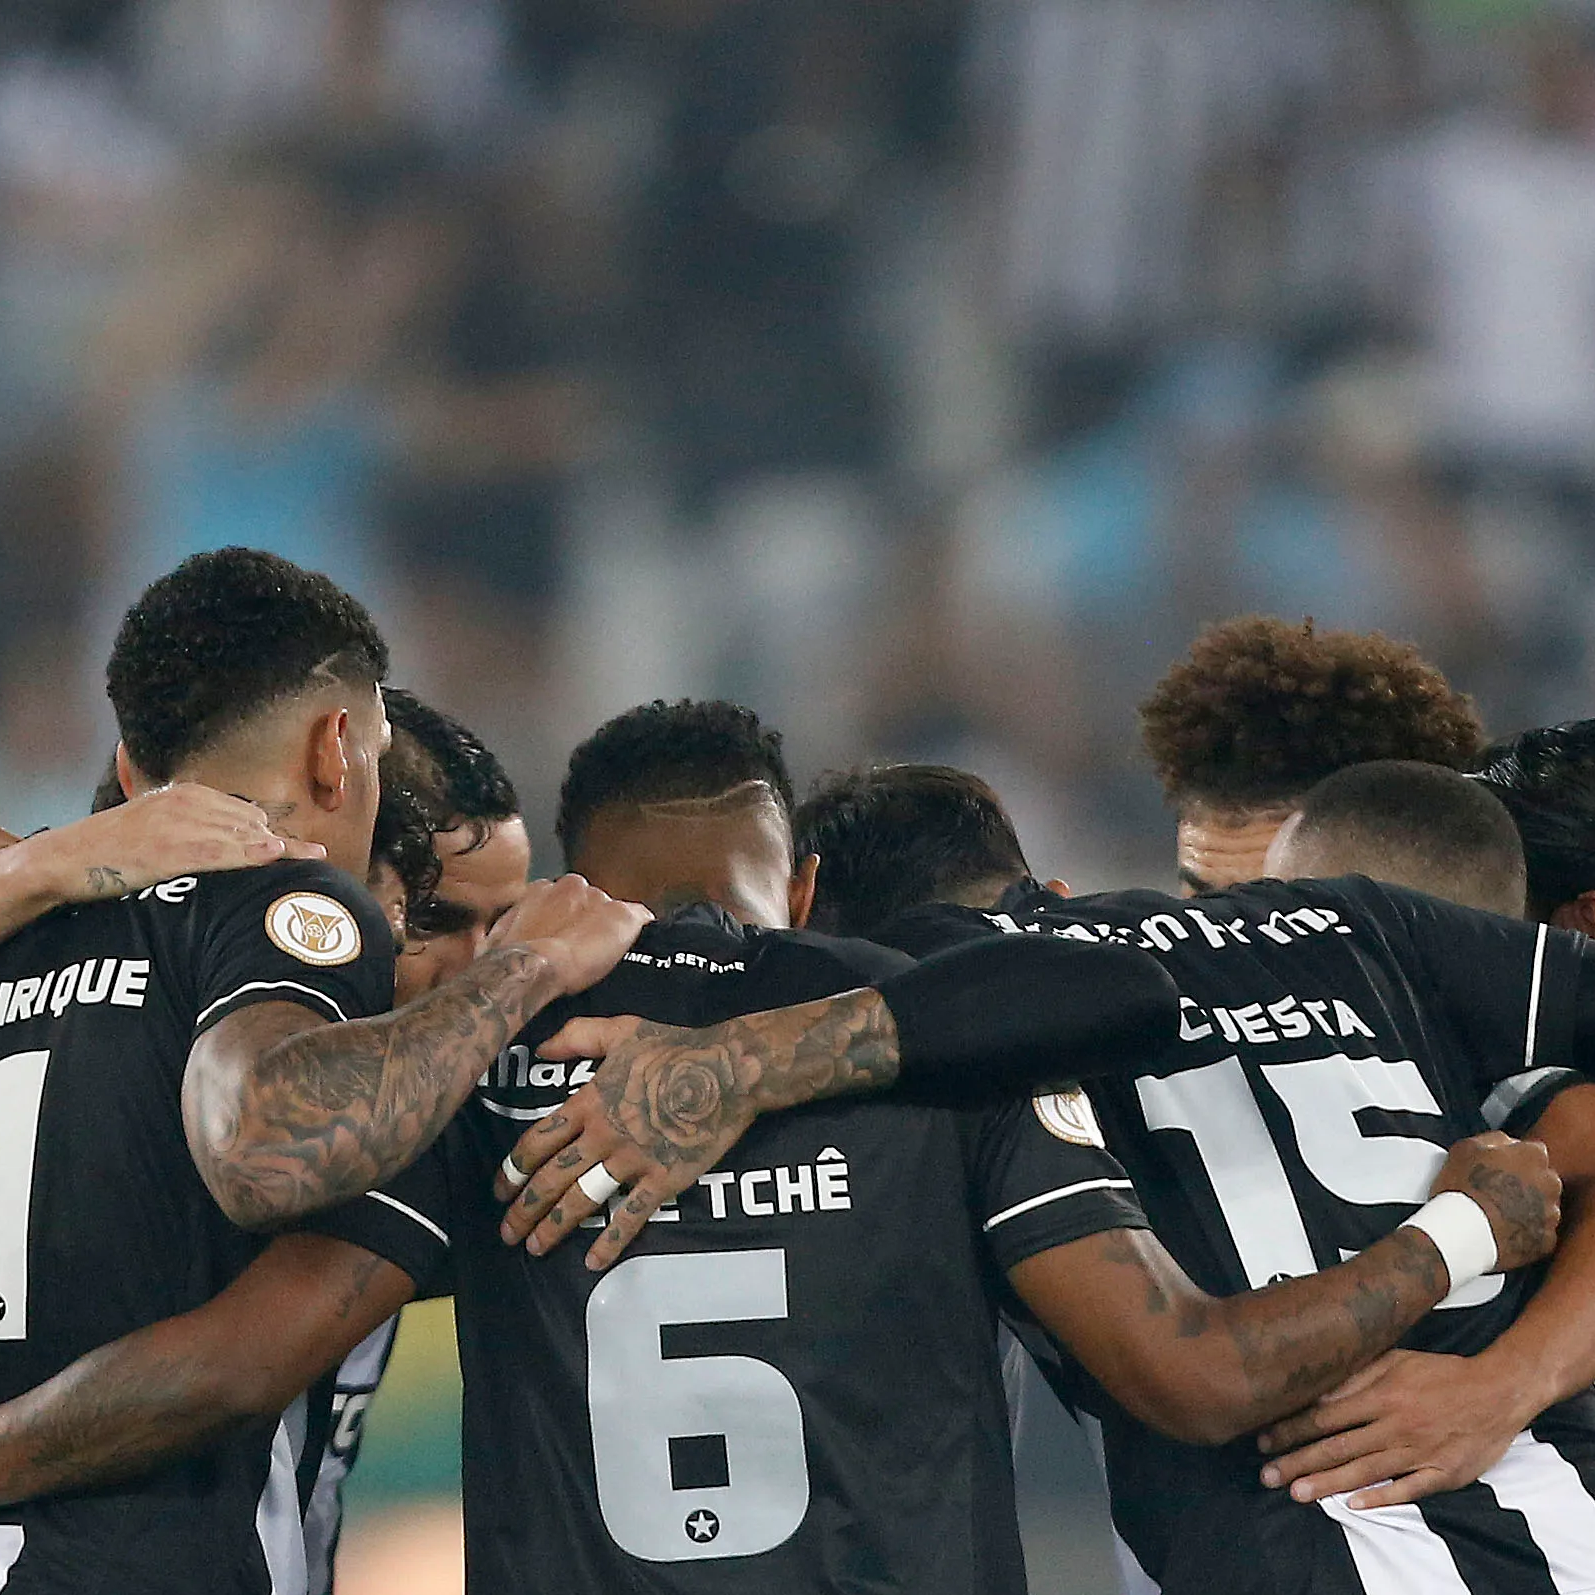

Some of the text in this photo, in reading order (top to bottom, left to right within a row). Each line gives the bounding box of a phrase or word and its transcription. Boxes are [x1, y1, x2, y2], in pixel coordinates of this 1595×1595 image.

[623, 951, 653, 965] IME
[674, 952, 707, 969] SET
[698, 1146, 853, 1220] TCHÊ
[1134, 1053, 1507, 1311] 15
[585, 1248, 811, 1563] 6
